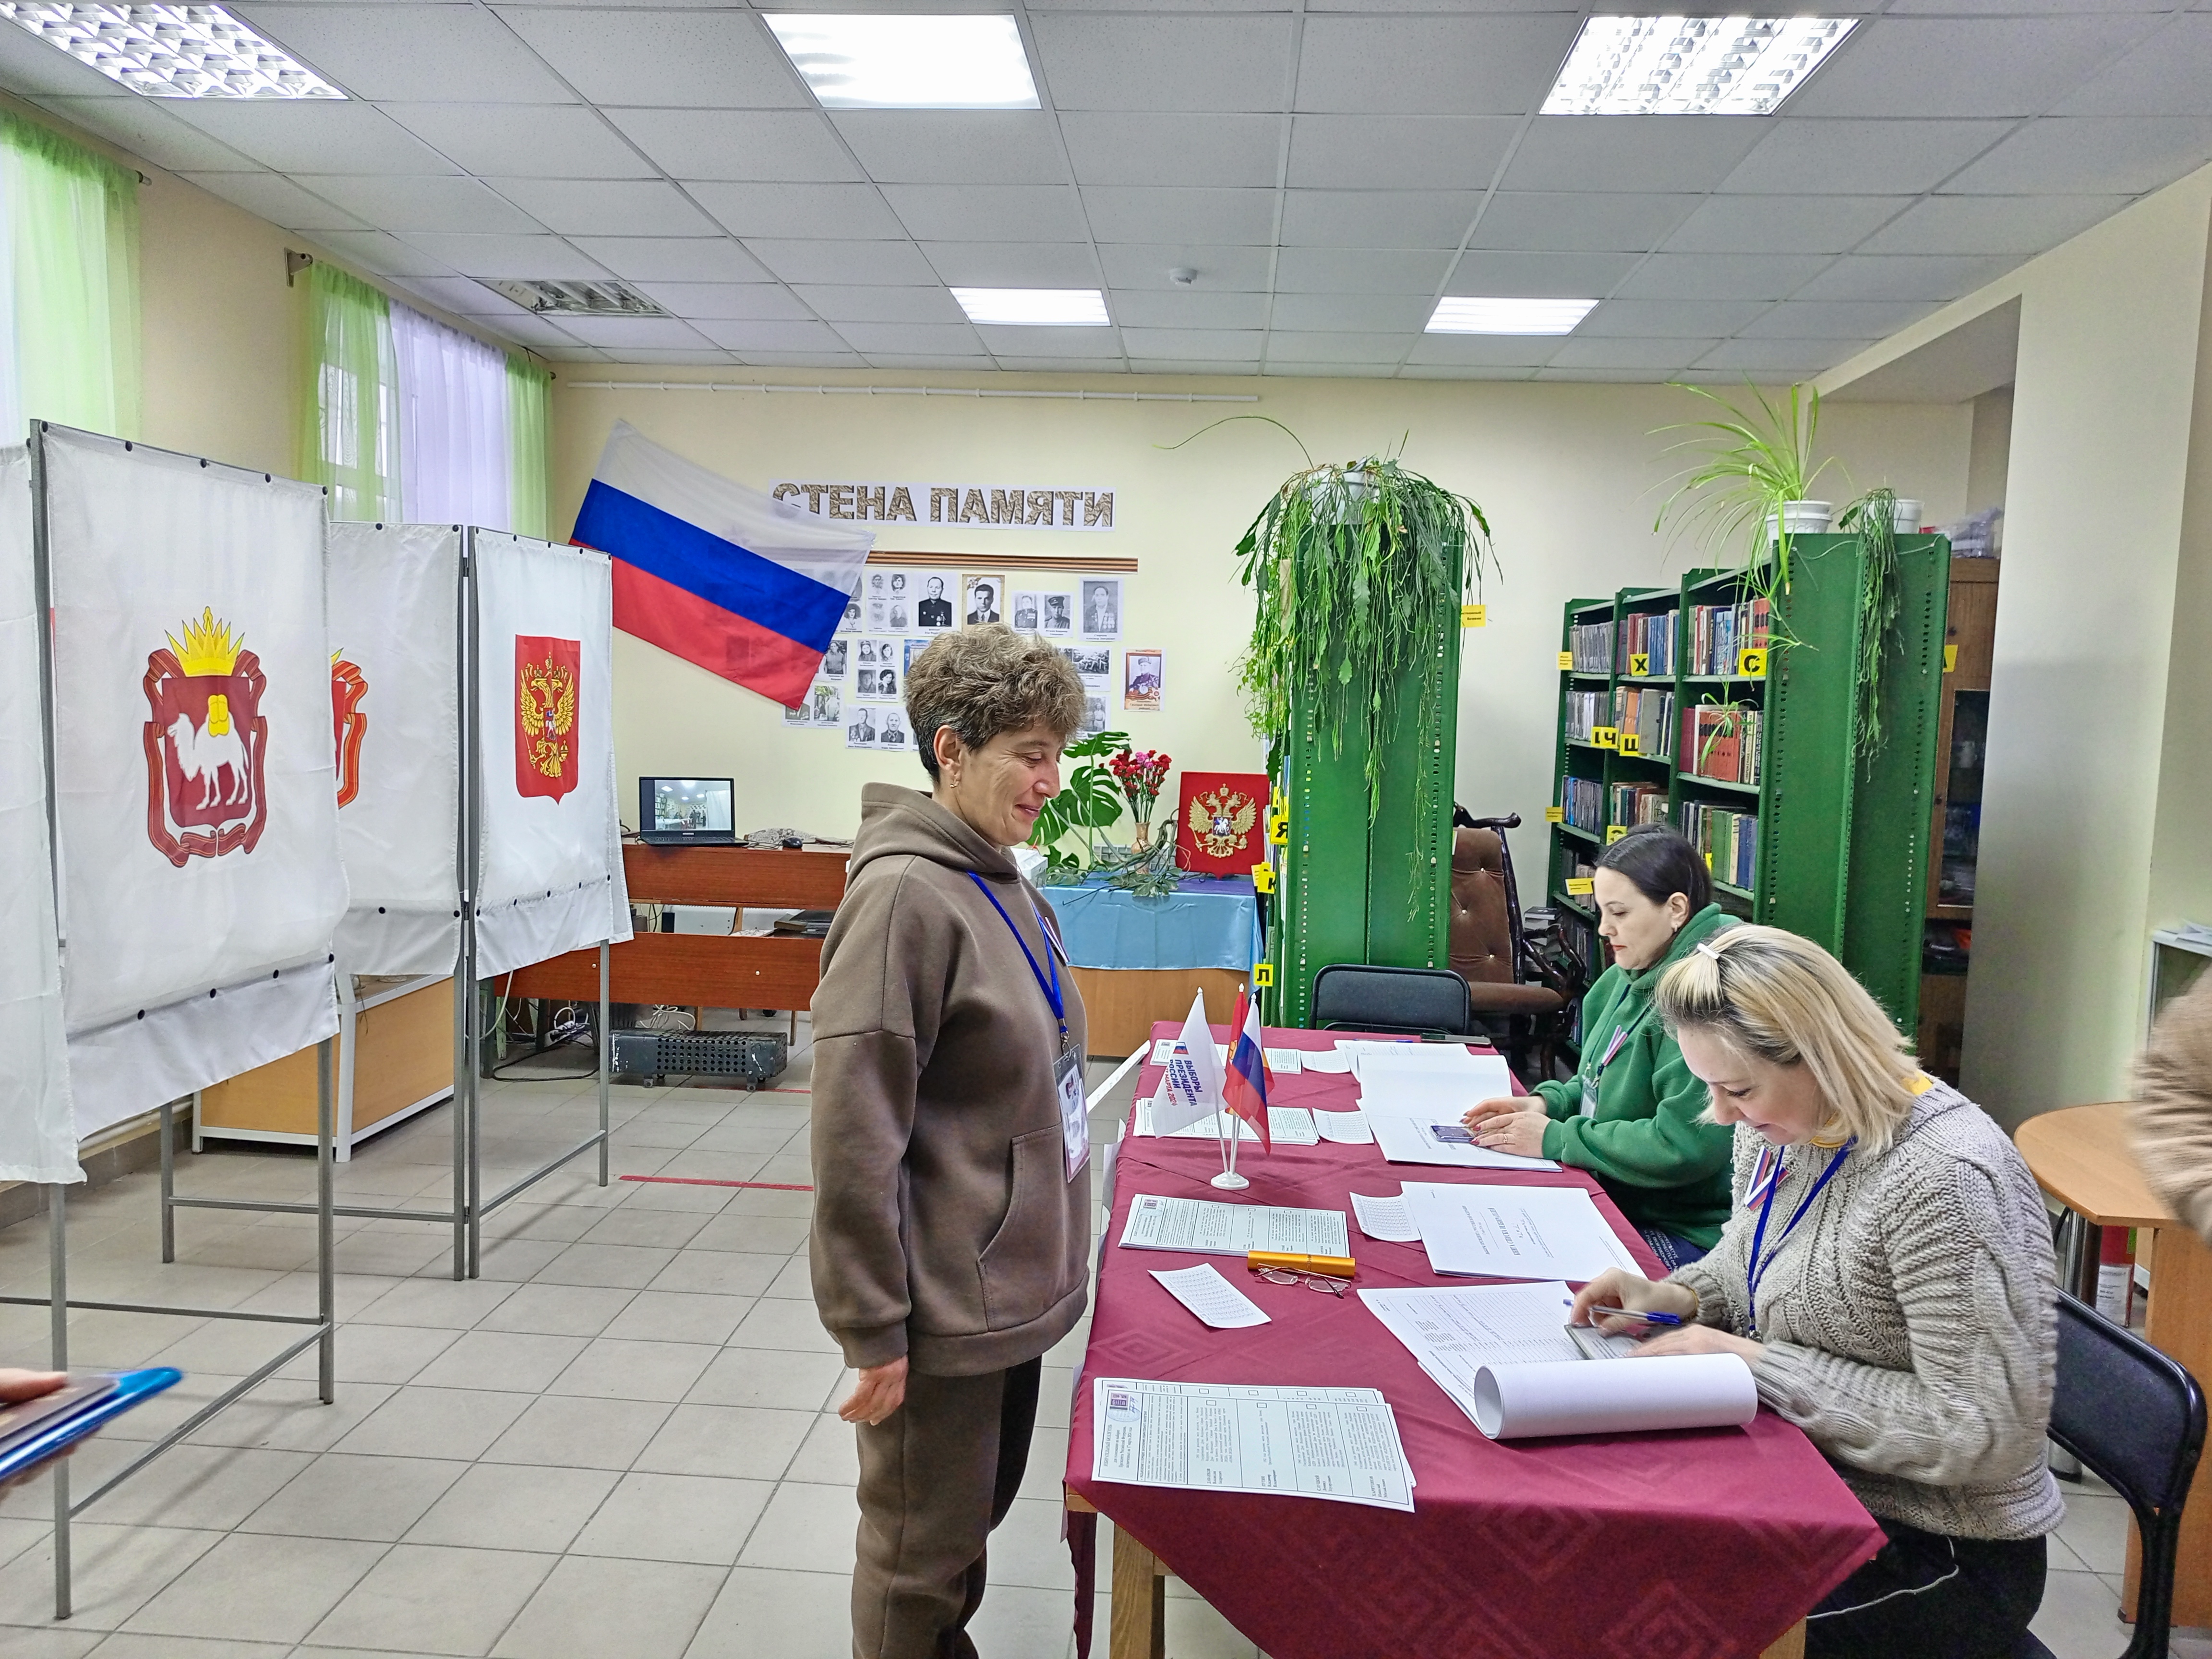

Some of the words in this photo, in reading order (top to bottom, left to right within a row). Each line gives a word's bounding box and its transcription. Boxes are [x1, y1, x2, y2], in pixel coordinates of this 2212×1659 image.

[772, 482, 917, 522] СТЕНА
[930, 487, 1114, 527] ПАМЯТИ
[1634, 658, 1647, 672] Х
[1743, 655, 1760, 673] С
[1604, 732, 1616, 745] Ч
[1275, 821, 1288, 839] Я
[1257, 969, 1270, 982] Л
[1169, 1059, 1181, 1089] РОССИИ
[1175, 1059, 1198, 1106] ПРЕЗИДЕНТА
[1184, 1060, 1203, 1092] ВЫБОРЫ
